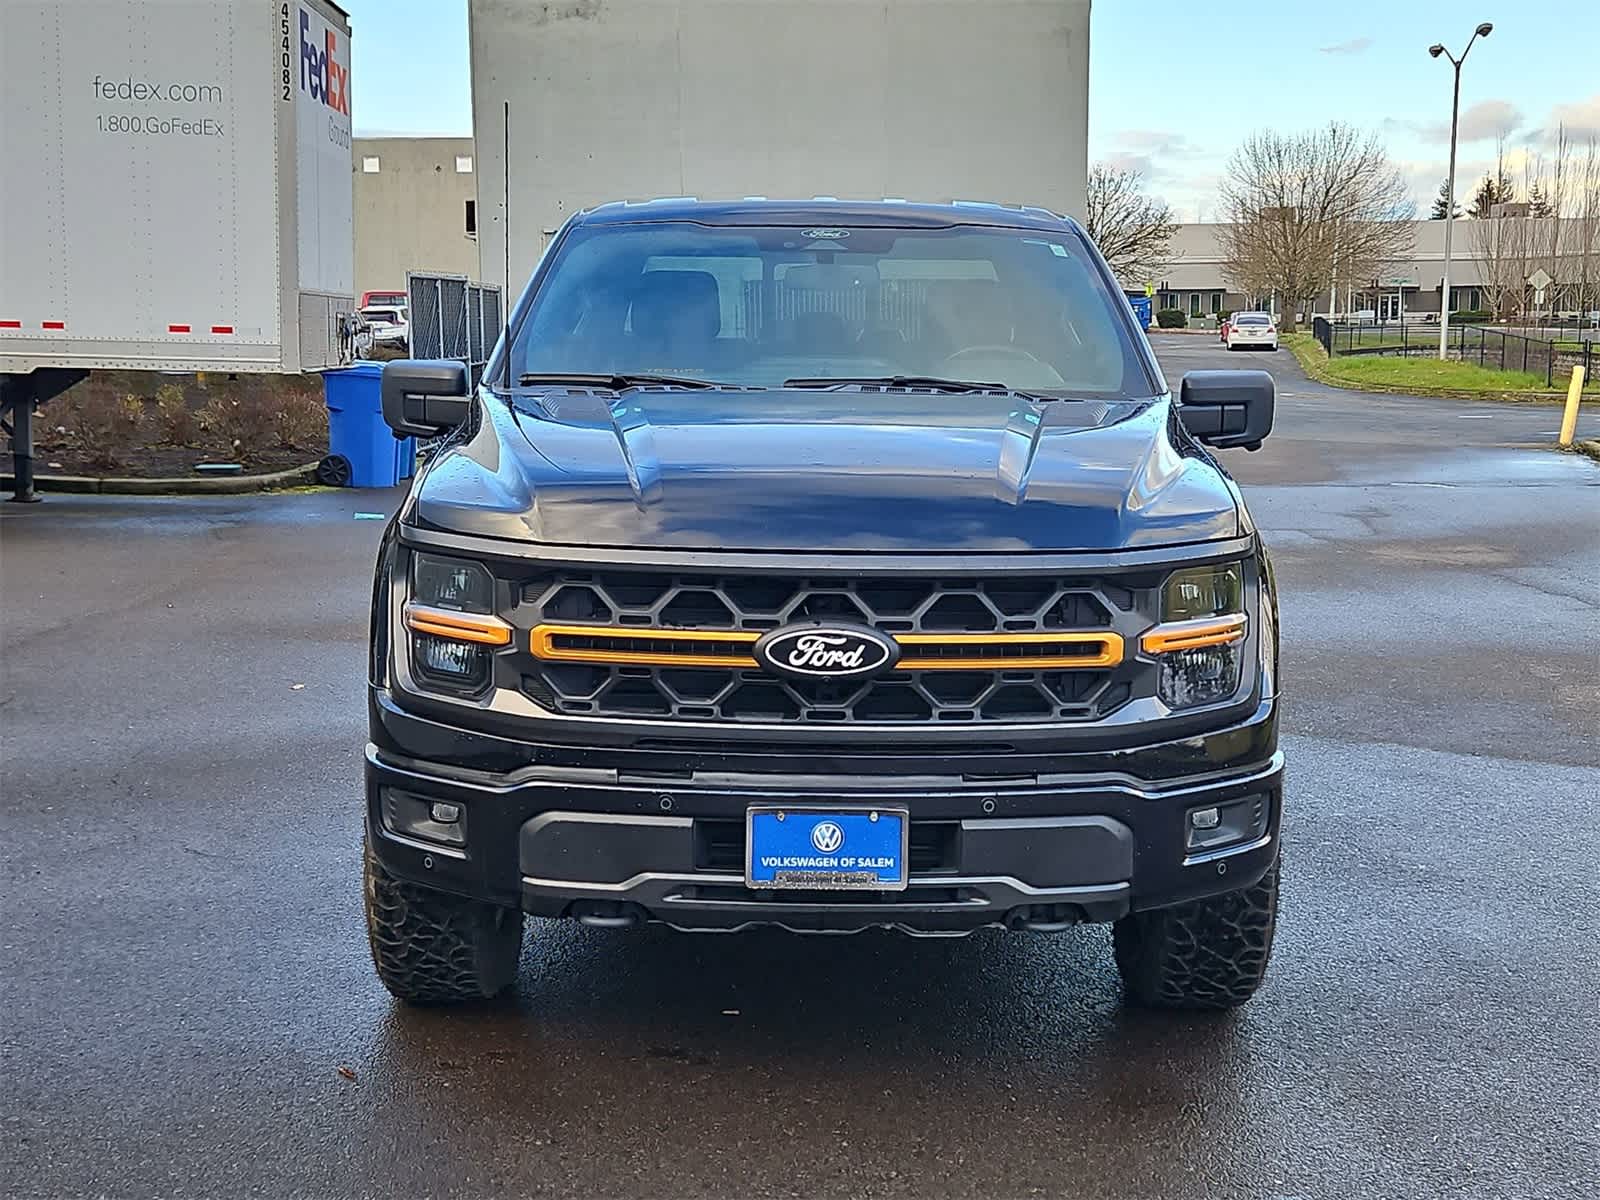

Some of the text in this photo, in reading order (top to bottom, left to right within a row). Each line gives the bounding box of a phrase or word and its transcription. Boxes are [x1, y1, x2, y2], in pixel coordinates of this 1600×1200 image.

[281, 2, 291, 102] 454082
[299, 7, 348, 116] FedEx
[92, 75, 222, 103] fedex.com
[96, 115, 225, 136] 1.800.GoFedEx
[788, 635, 866, 668] Ford
[761, 856, 895, 868] VOLKSWAGEN OF SALEM
